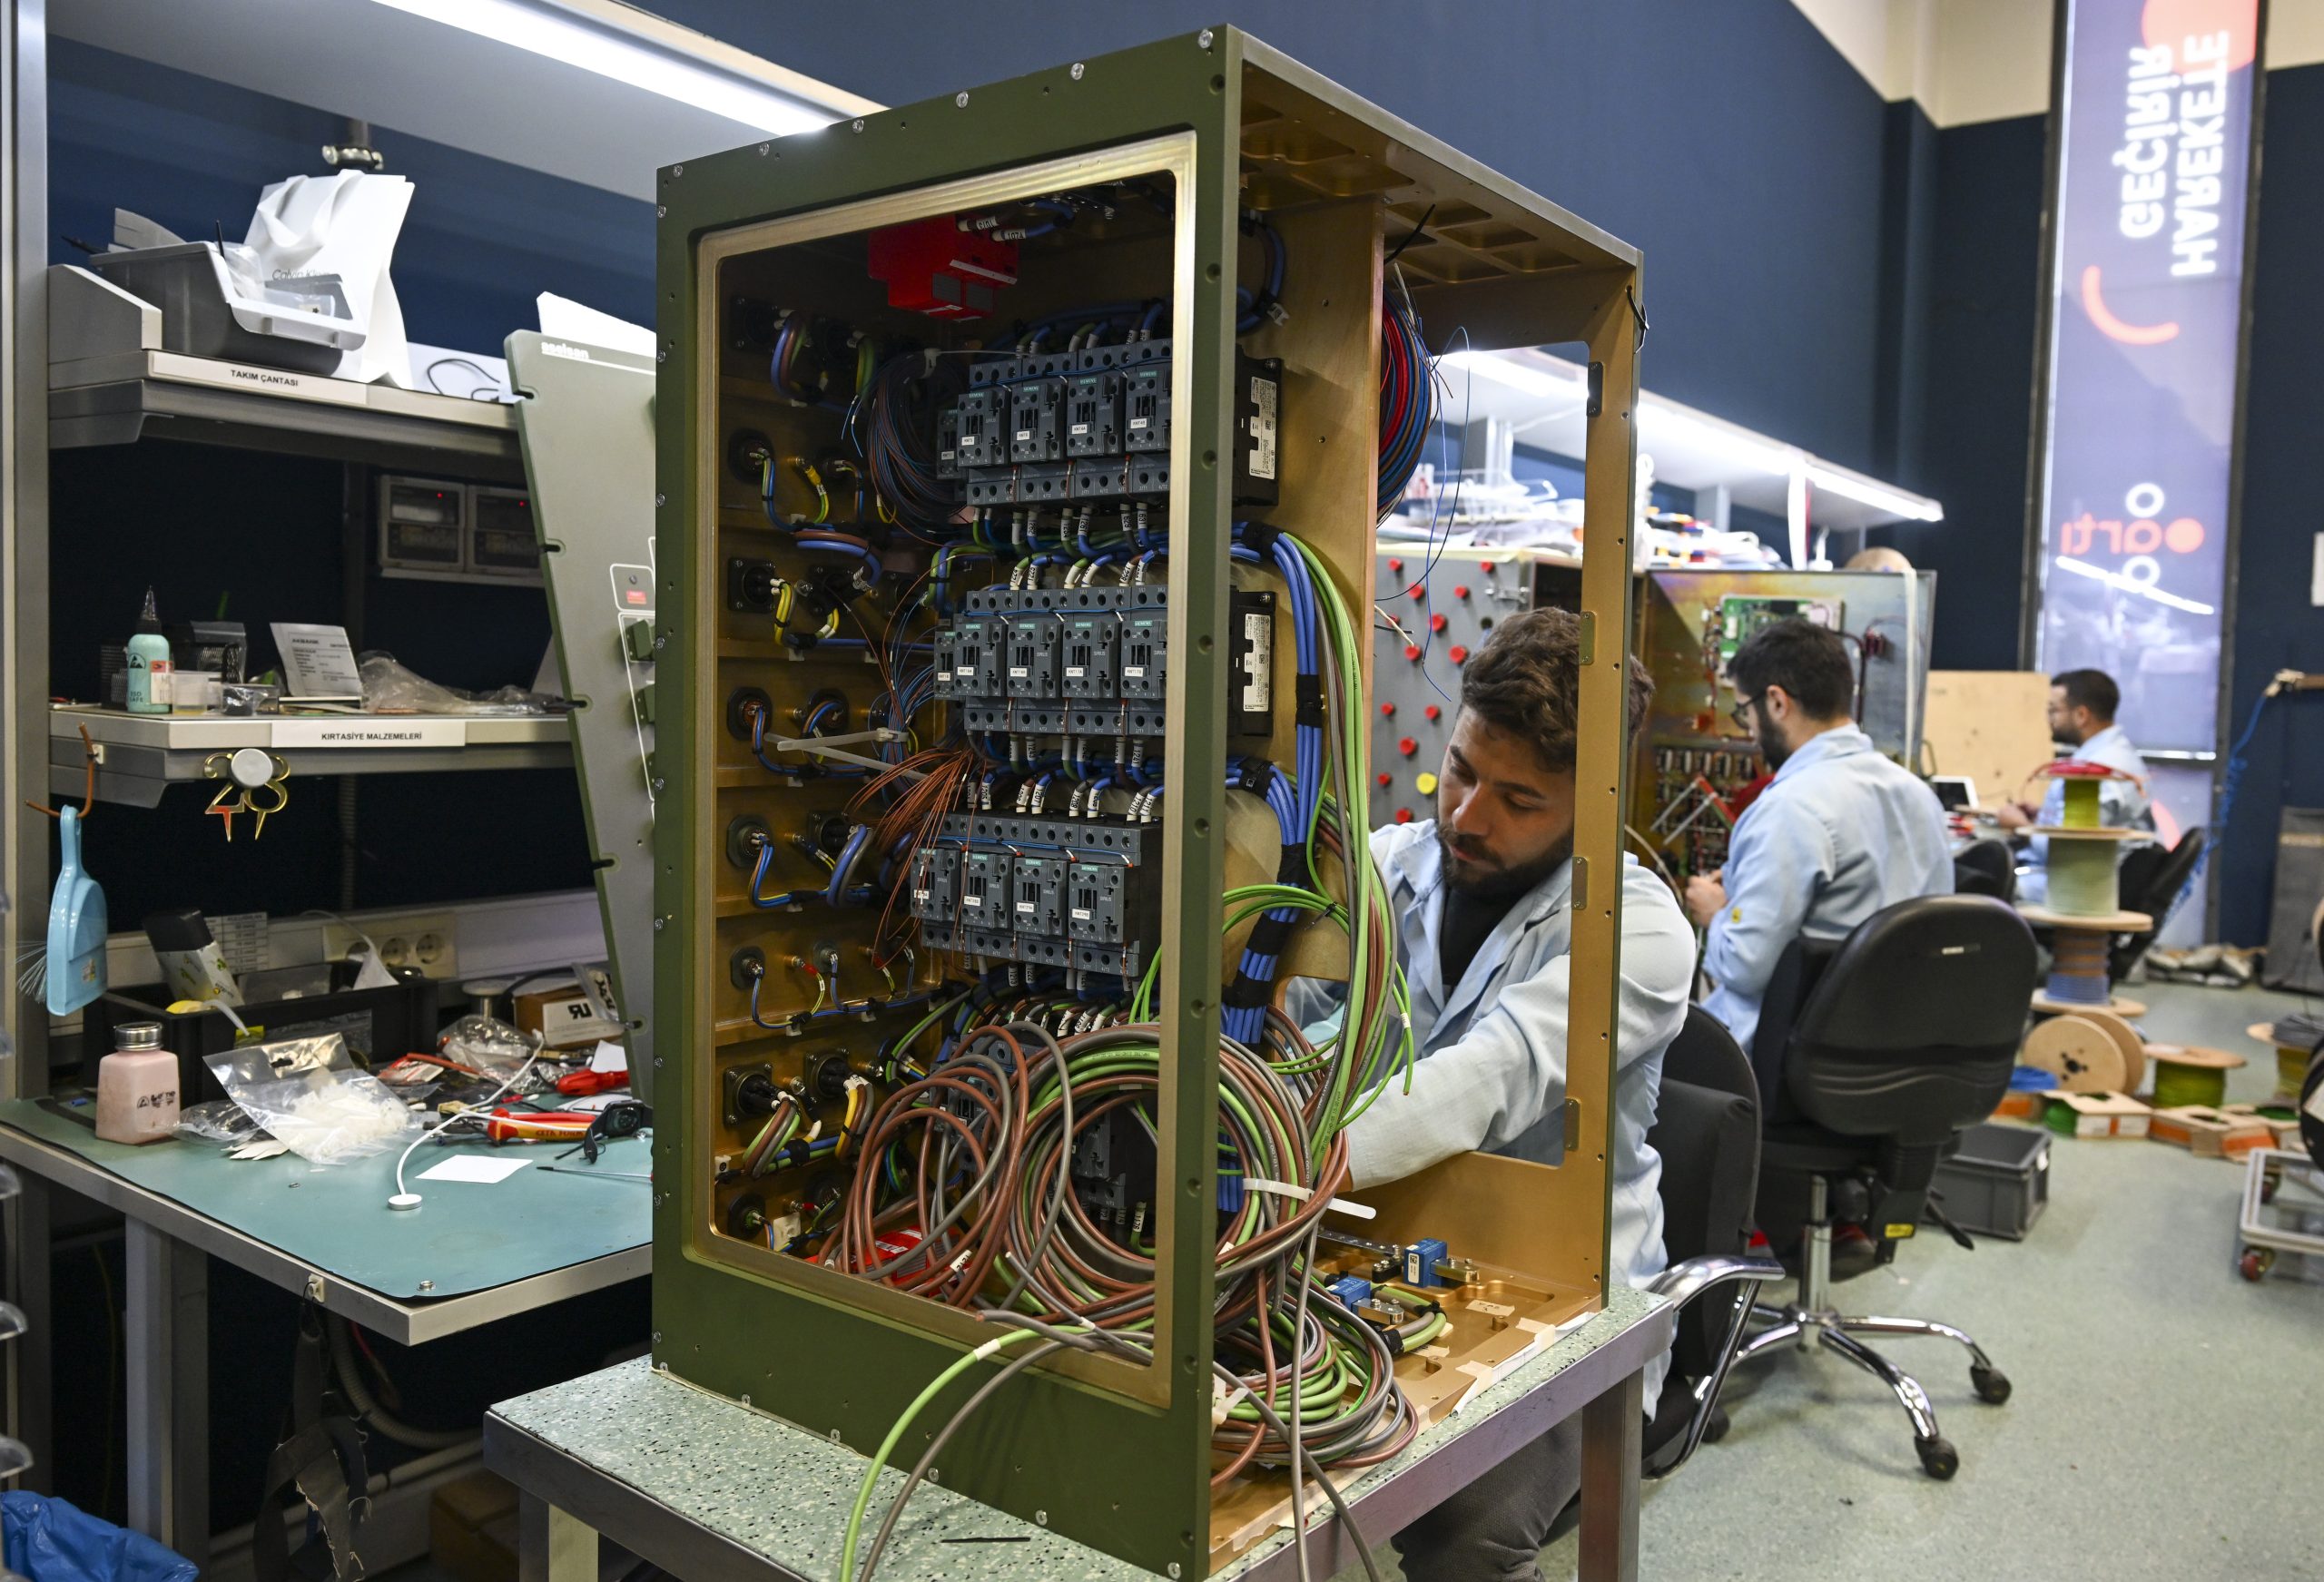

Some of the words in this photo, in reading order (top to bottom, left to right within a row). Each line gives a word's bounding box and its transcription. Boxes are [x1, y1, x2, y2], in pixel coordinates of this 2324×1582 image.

[231, 369, 260, 380] TAKIM
[260, 375, 300, 387] ÇANTASI
[321, 731, 365, 741] KIRTASİYE
[366, 732, 422, 741] MALZEMELERİ
